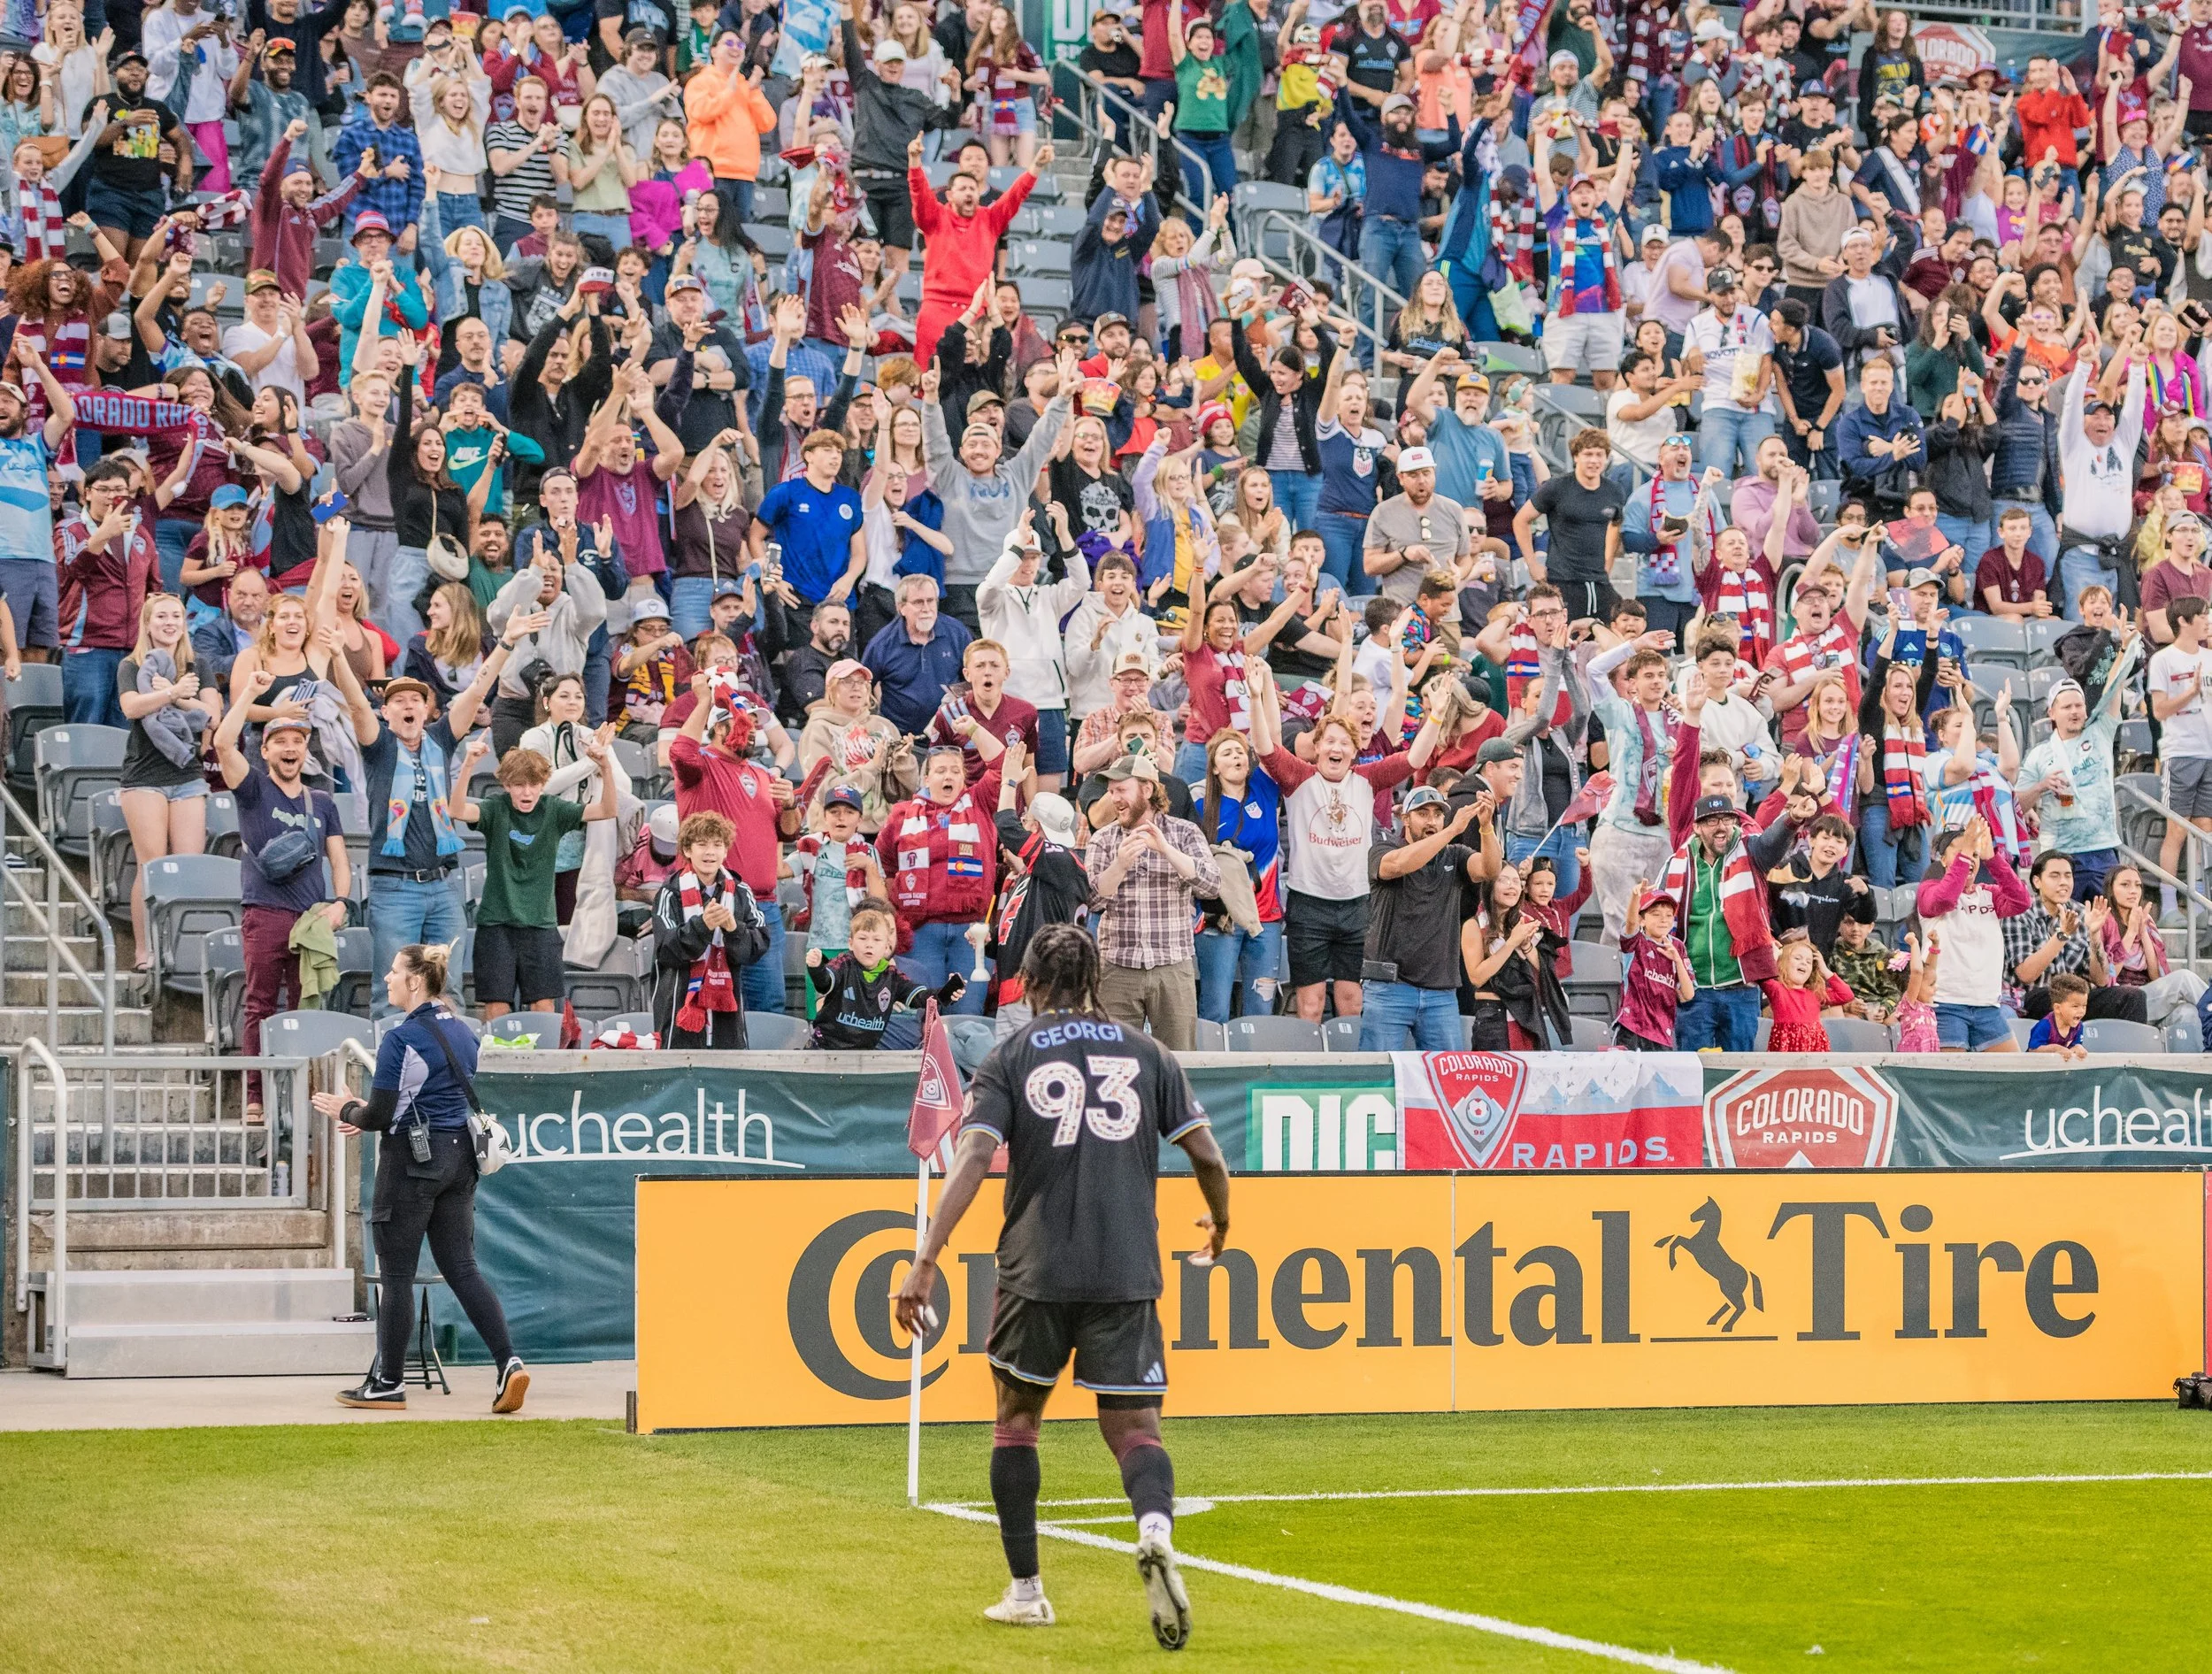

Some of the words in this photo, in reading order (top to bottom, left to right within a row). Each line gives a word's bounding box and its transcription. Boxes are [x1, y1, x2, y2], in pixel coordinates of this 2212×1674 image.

[1309, 832, 1363, 848] Budweiser
[836, 1011, 886, 1031] uchealth
[1030, 1021, 1125, 1049] GEORGI
[1439, 1053, 1513, 1079] COLORADO
[1455, 1073, 1499, 1082] RAPIDS
[1025, 1055, 1141, 1147] 93
[1736, 1087, 1864, 1136] COLORADO
[1763, 1131, 1838, 1144] RAPIDS
[1511, 1136, 1667, 1168] RAPIDS
[1767, 1202, 2100, 1342] Tire
